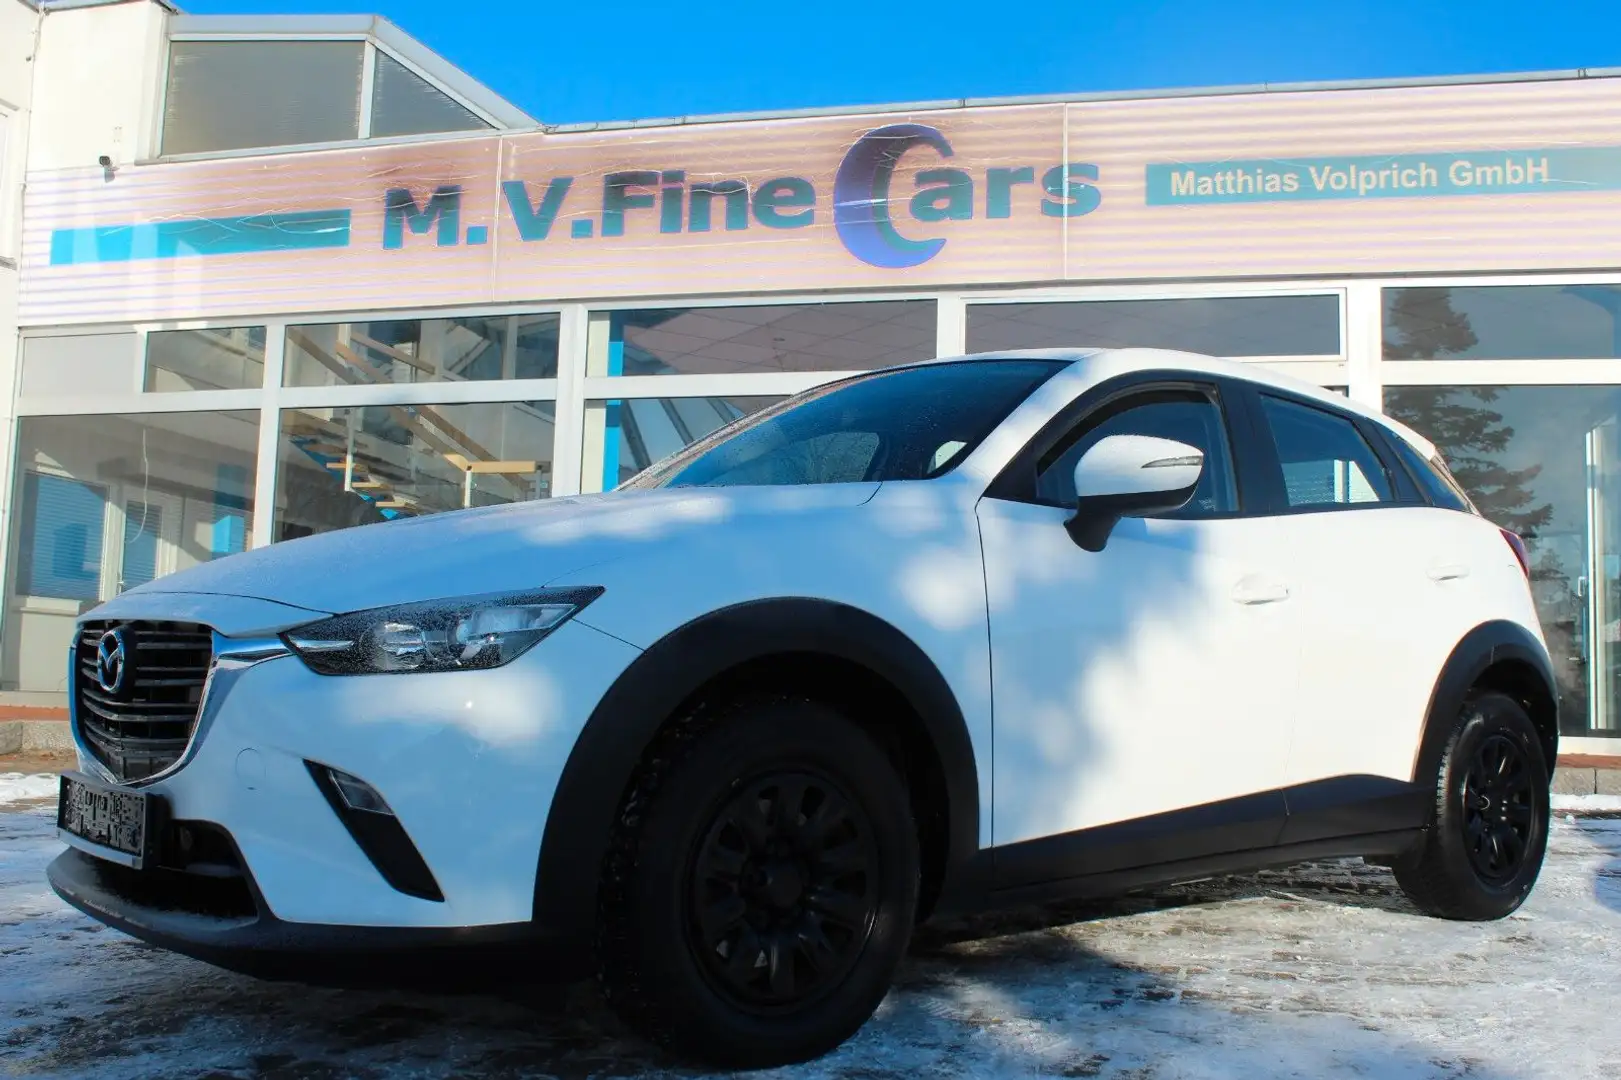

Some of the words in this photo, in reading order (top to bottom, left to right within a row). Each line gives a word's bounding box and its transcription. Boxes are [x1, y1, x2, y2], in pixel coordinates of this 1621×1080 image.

[1171, 168, 1299, 196] Matthias
[1309, 162, 1437, 195] Volprich
[1449, 157, 1549, 186] GmbH
